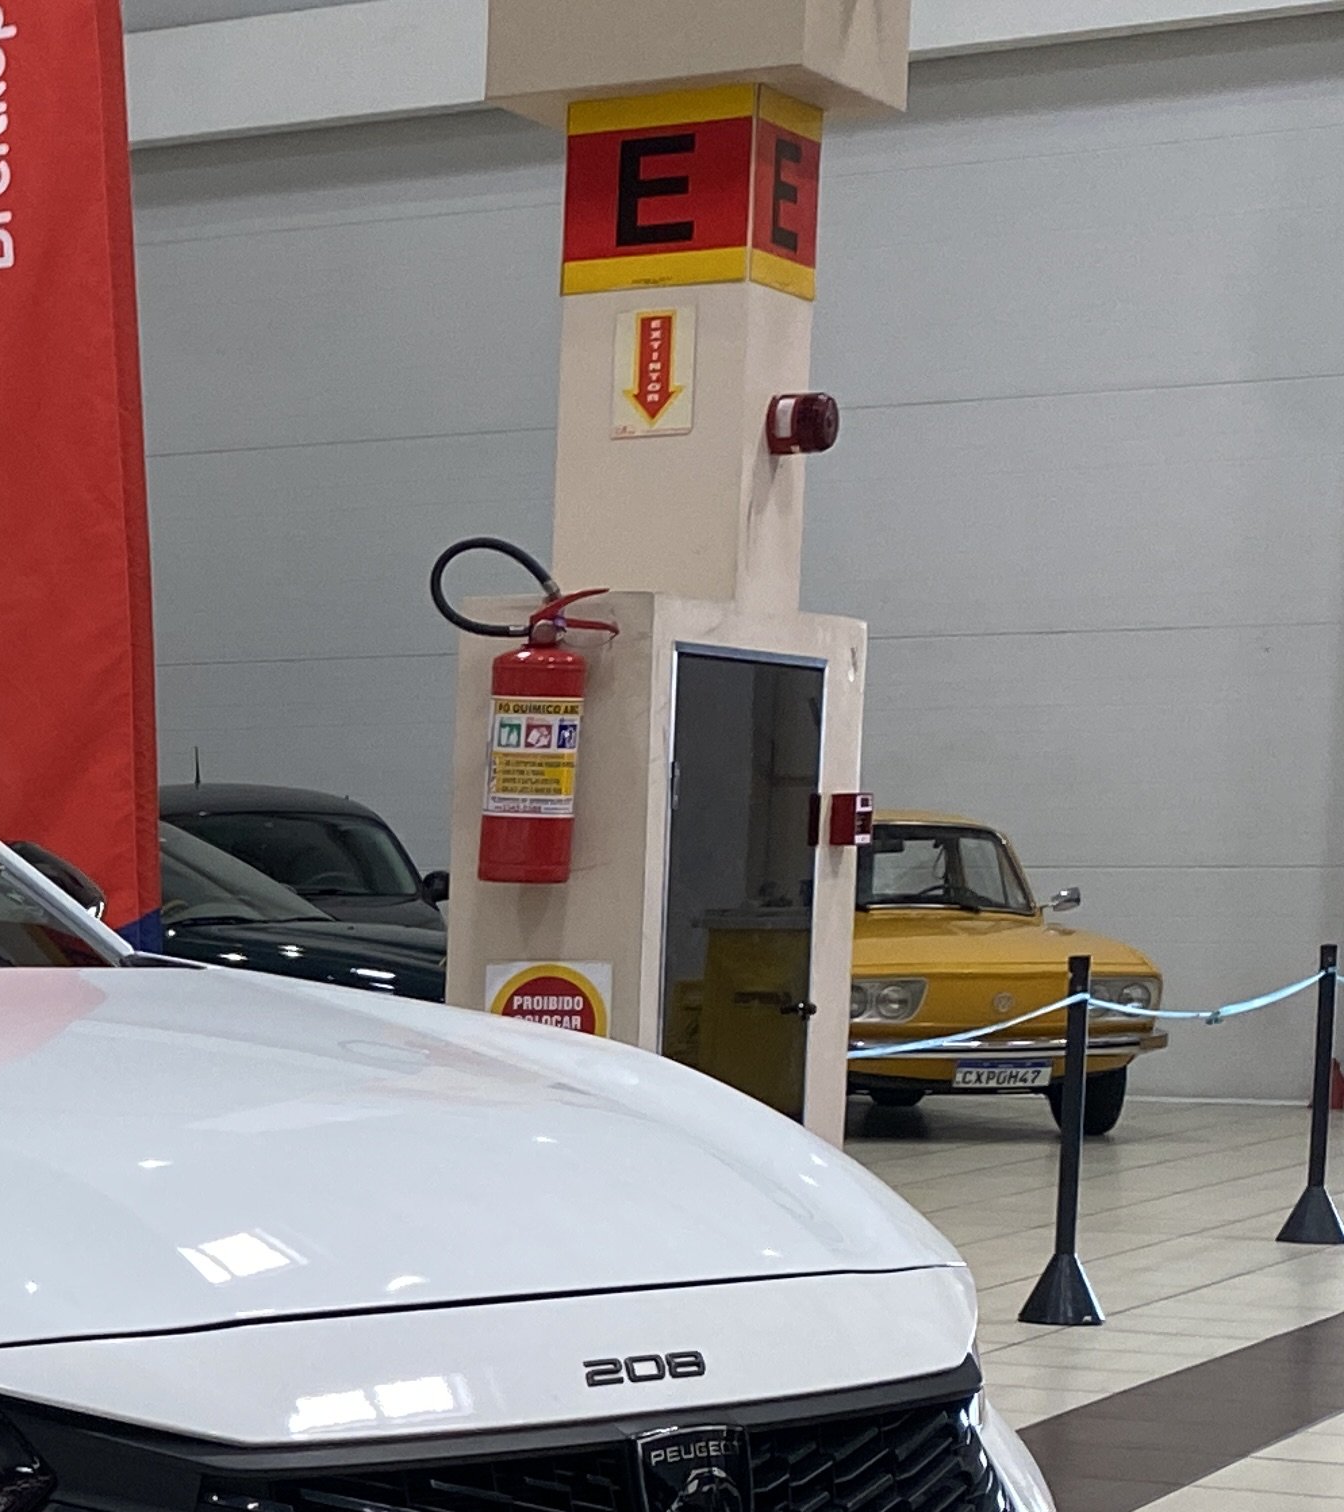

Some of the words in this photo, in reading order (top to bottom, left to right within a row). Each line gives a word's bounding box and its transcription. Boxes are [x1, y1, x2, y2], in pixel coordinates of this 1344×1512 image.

[615, 132, 697, 248] E
[770, 137, 803, 255] E
[512, 995, 584, 1011] PROIBIDO
[582, 1350, 707, 1388] 208
